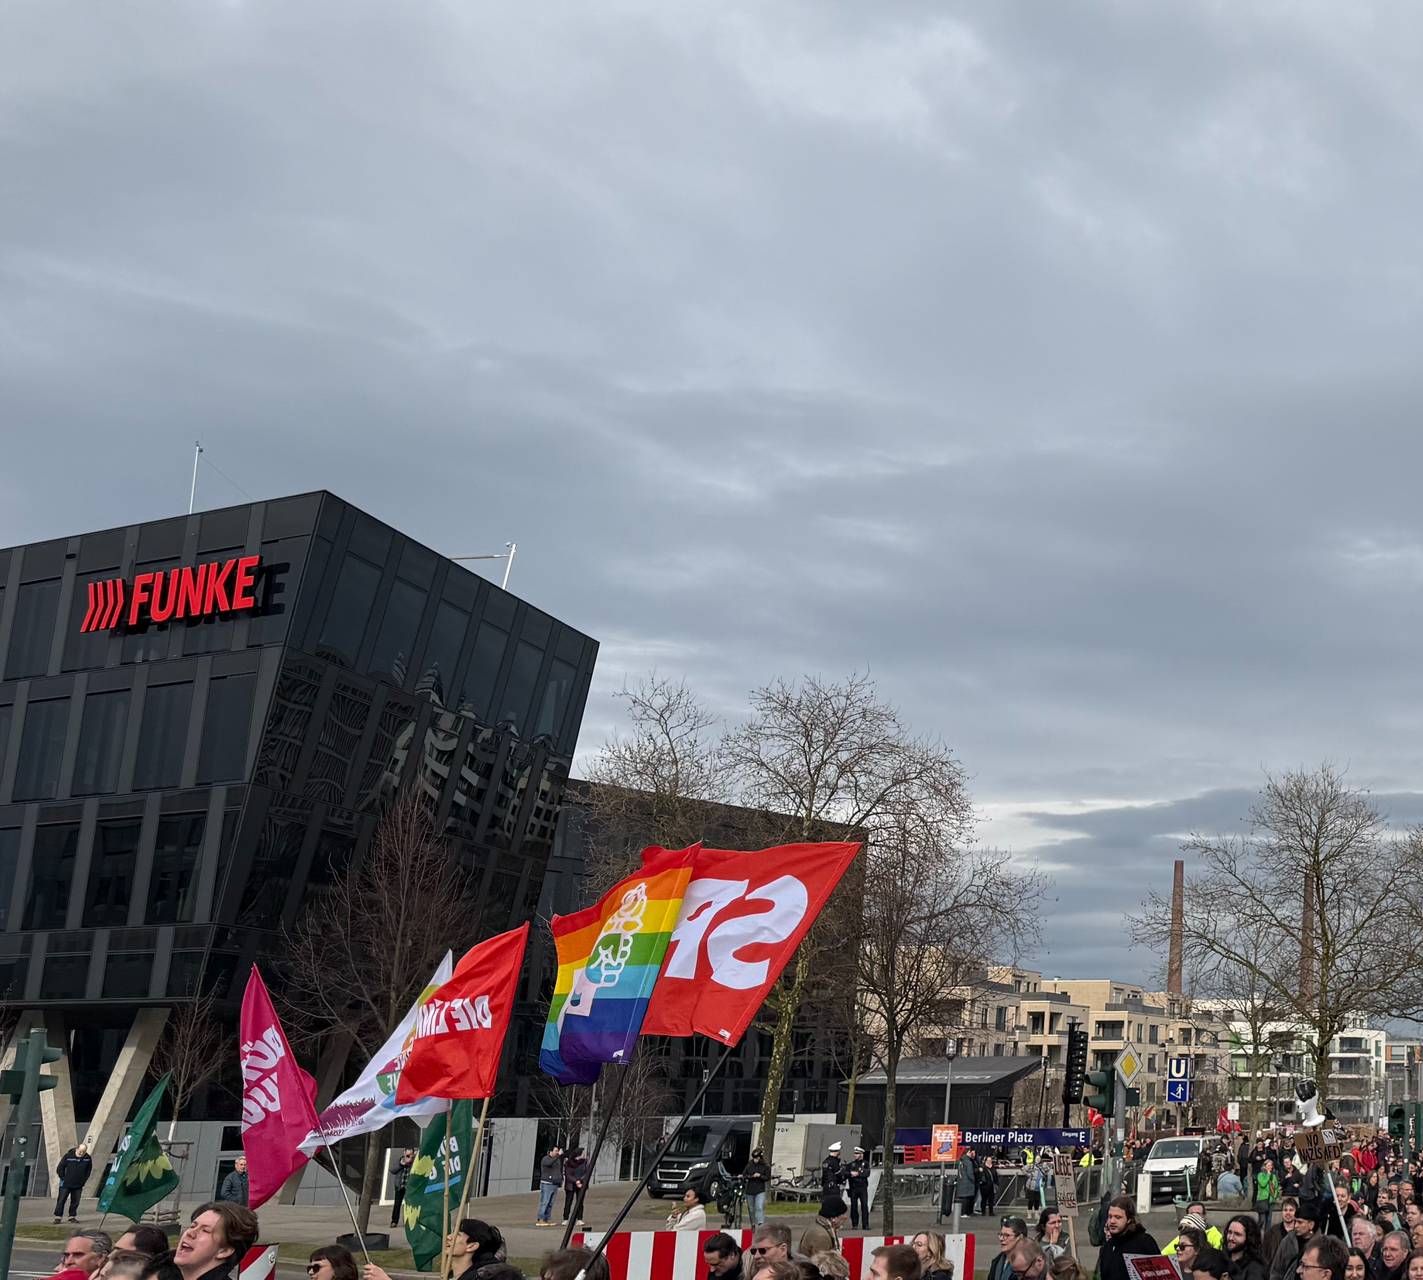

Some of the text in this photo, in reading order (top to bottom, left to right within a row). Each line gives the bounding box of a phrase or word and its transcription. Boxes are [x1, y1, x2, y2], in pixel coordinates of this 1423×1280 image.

[129, 555, 260, 626] FUNKE
[1171, 1059, 1186, 1078] U
[965, 1132, 1004, 1143] Berliner
[1008, 1132, 1033, 1143] Platz
[1080, 1132, 1086, 1143] E
[1305, 1134, 1319, 1146] NO
[1300, 1148, 1322, 1164] NAZIS
